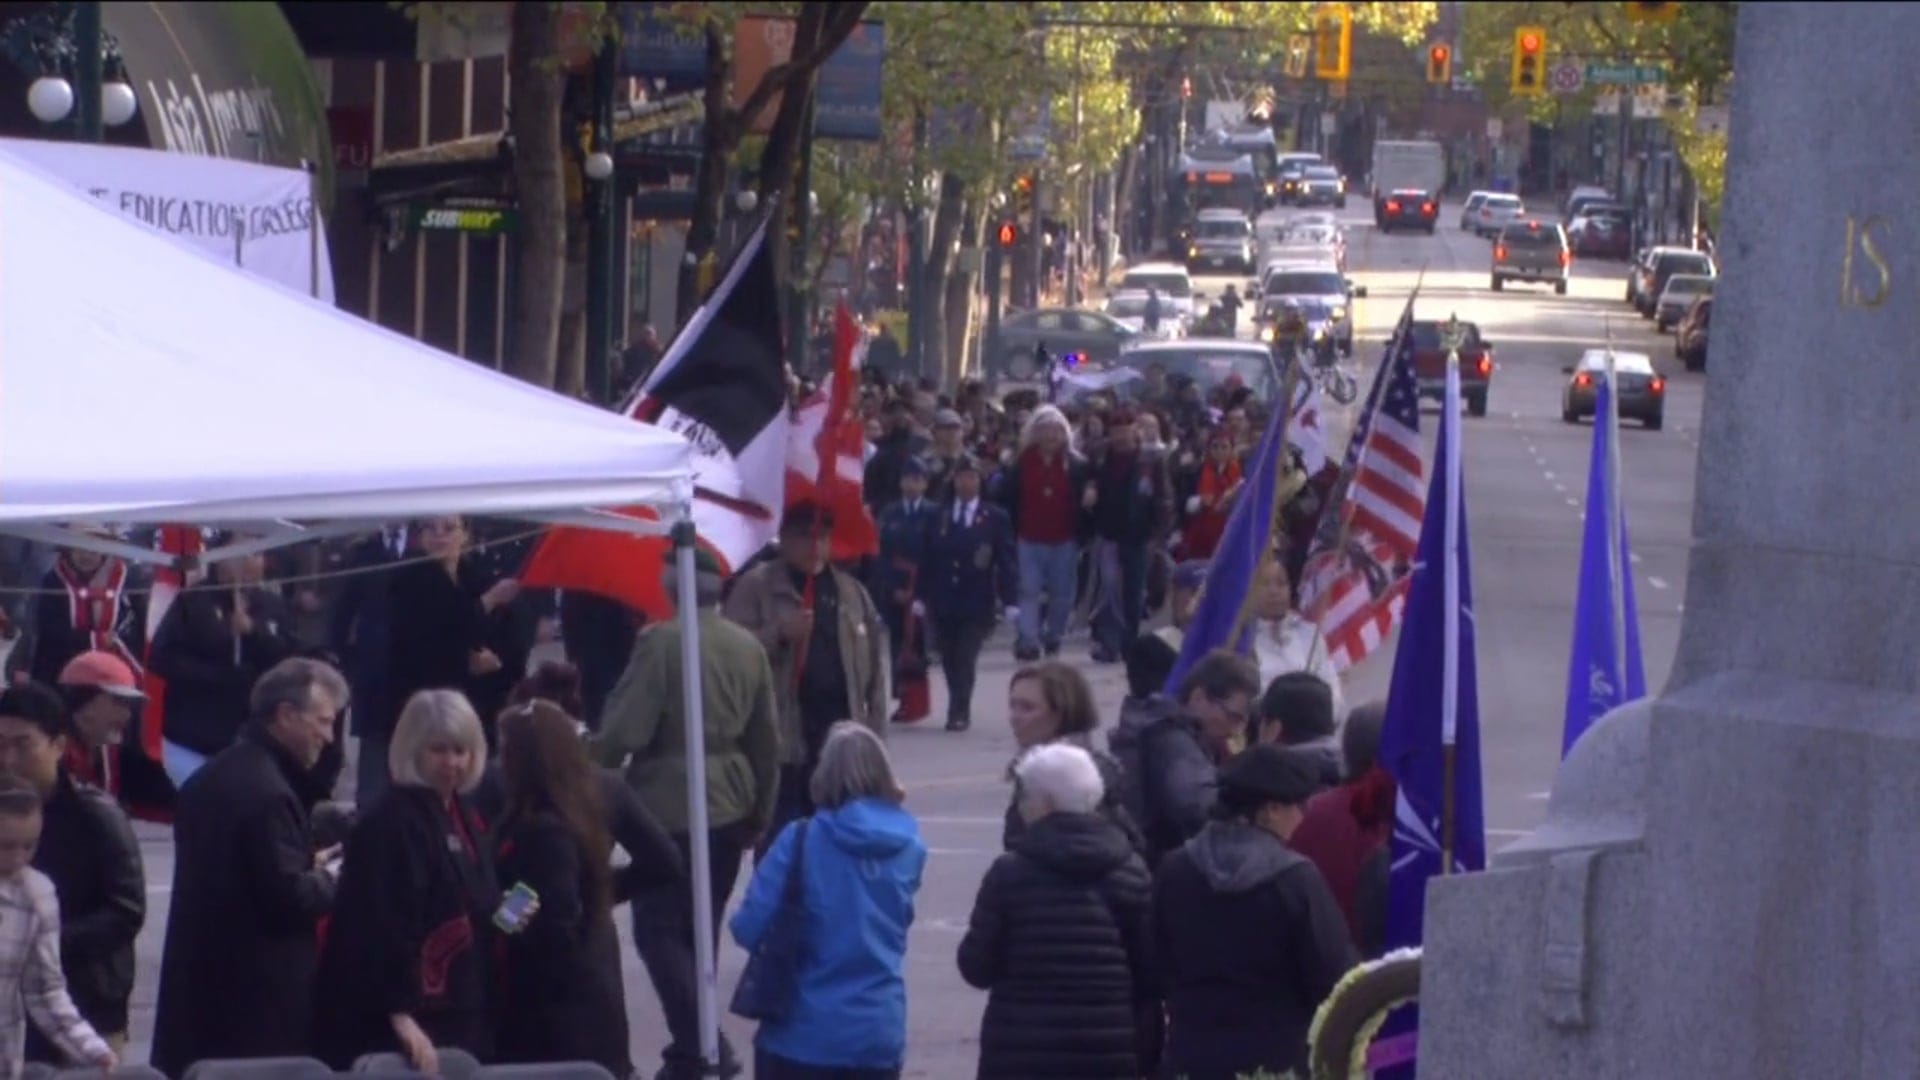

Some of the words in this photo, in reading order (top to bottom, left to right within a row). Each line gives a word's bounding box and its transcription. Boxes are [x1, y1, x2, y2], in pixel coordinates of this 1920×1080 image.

[120, 190, 247, 240] EDUCATION
[249, 197, 313, 241] COLLEG
[420, 209, 502, 229] SUBWAY
[1838, 211, 1894, 314] IS
